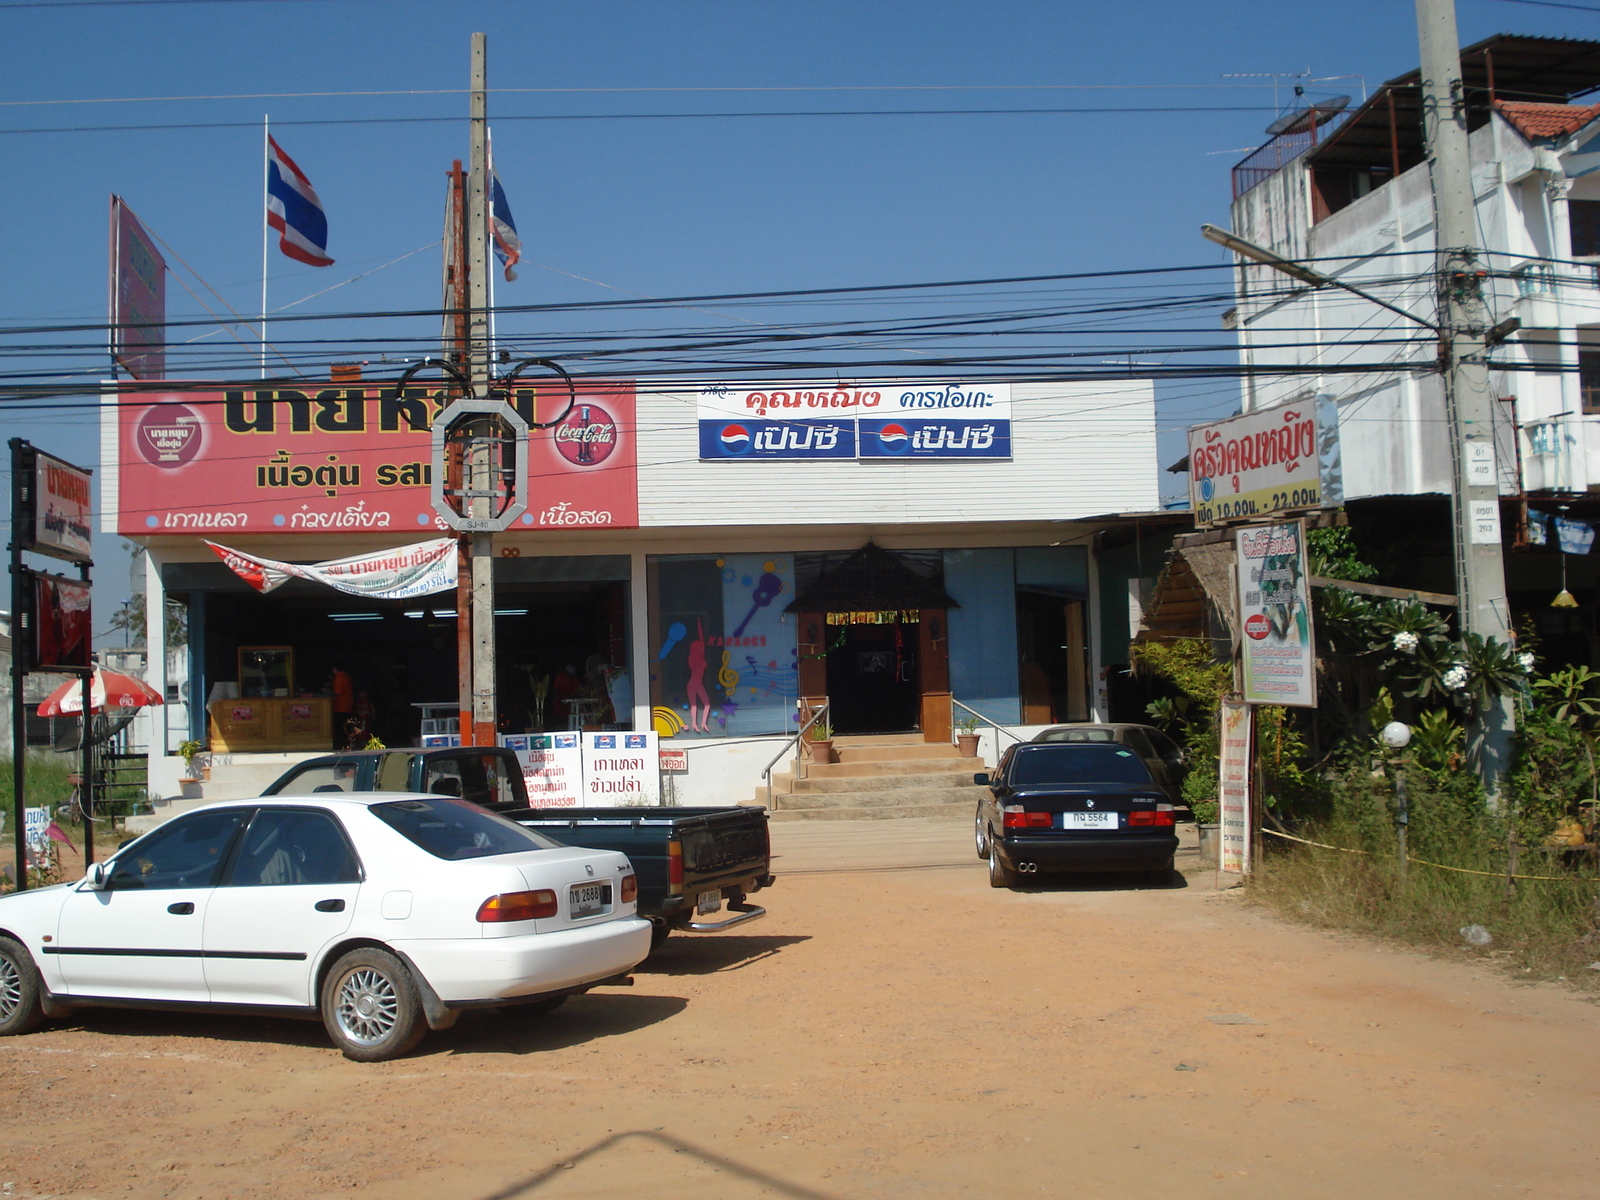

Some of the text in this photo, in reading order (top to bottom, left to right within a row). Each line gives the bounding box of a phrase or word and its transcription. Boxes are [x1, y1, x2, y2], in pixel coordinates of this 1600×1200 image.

[900, 384, 994, 408] คาราโอเกะ
[555, 423, 614, 444] Coca-Cola
[1193, 410, 1315, 494] ครัวคุณหญิง
[256, 449, 361, 498] เนื้อตุ๋น
[163, 511, 249, 528] เกาเหลา
[289, 500, 391, 528] ก๋วยเตี๋ยว
[538, 501, 612, 526] เนื้อสด
[661, 759, 685, 769] างออก
[590, 775, 641, 793] ข้าวเปล่า
